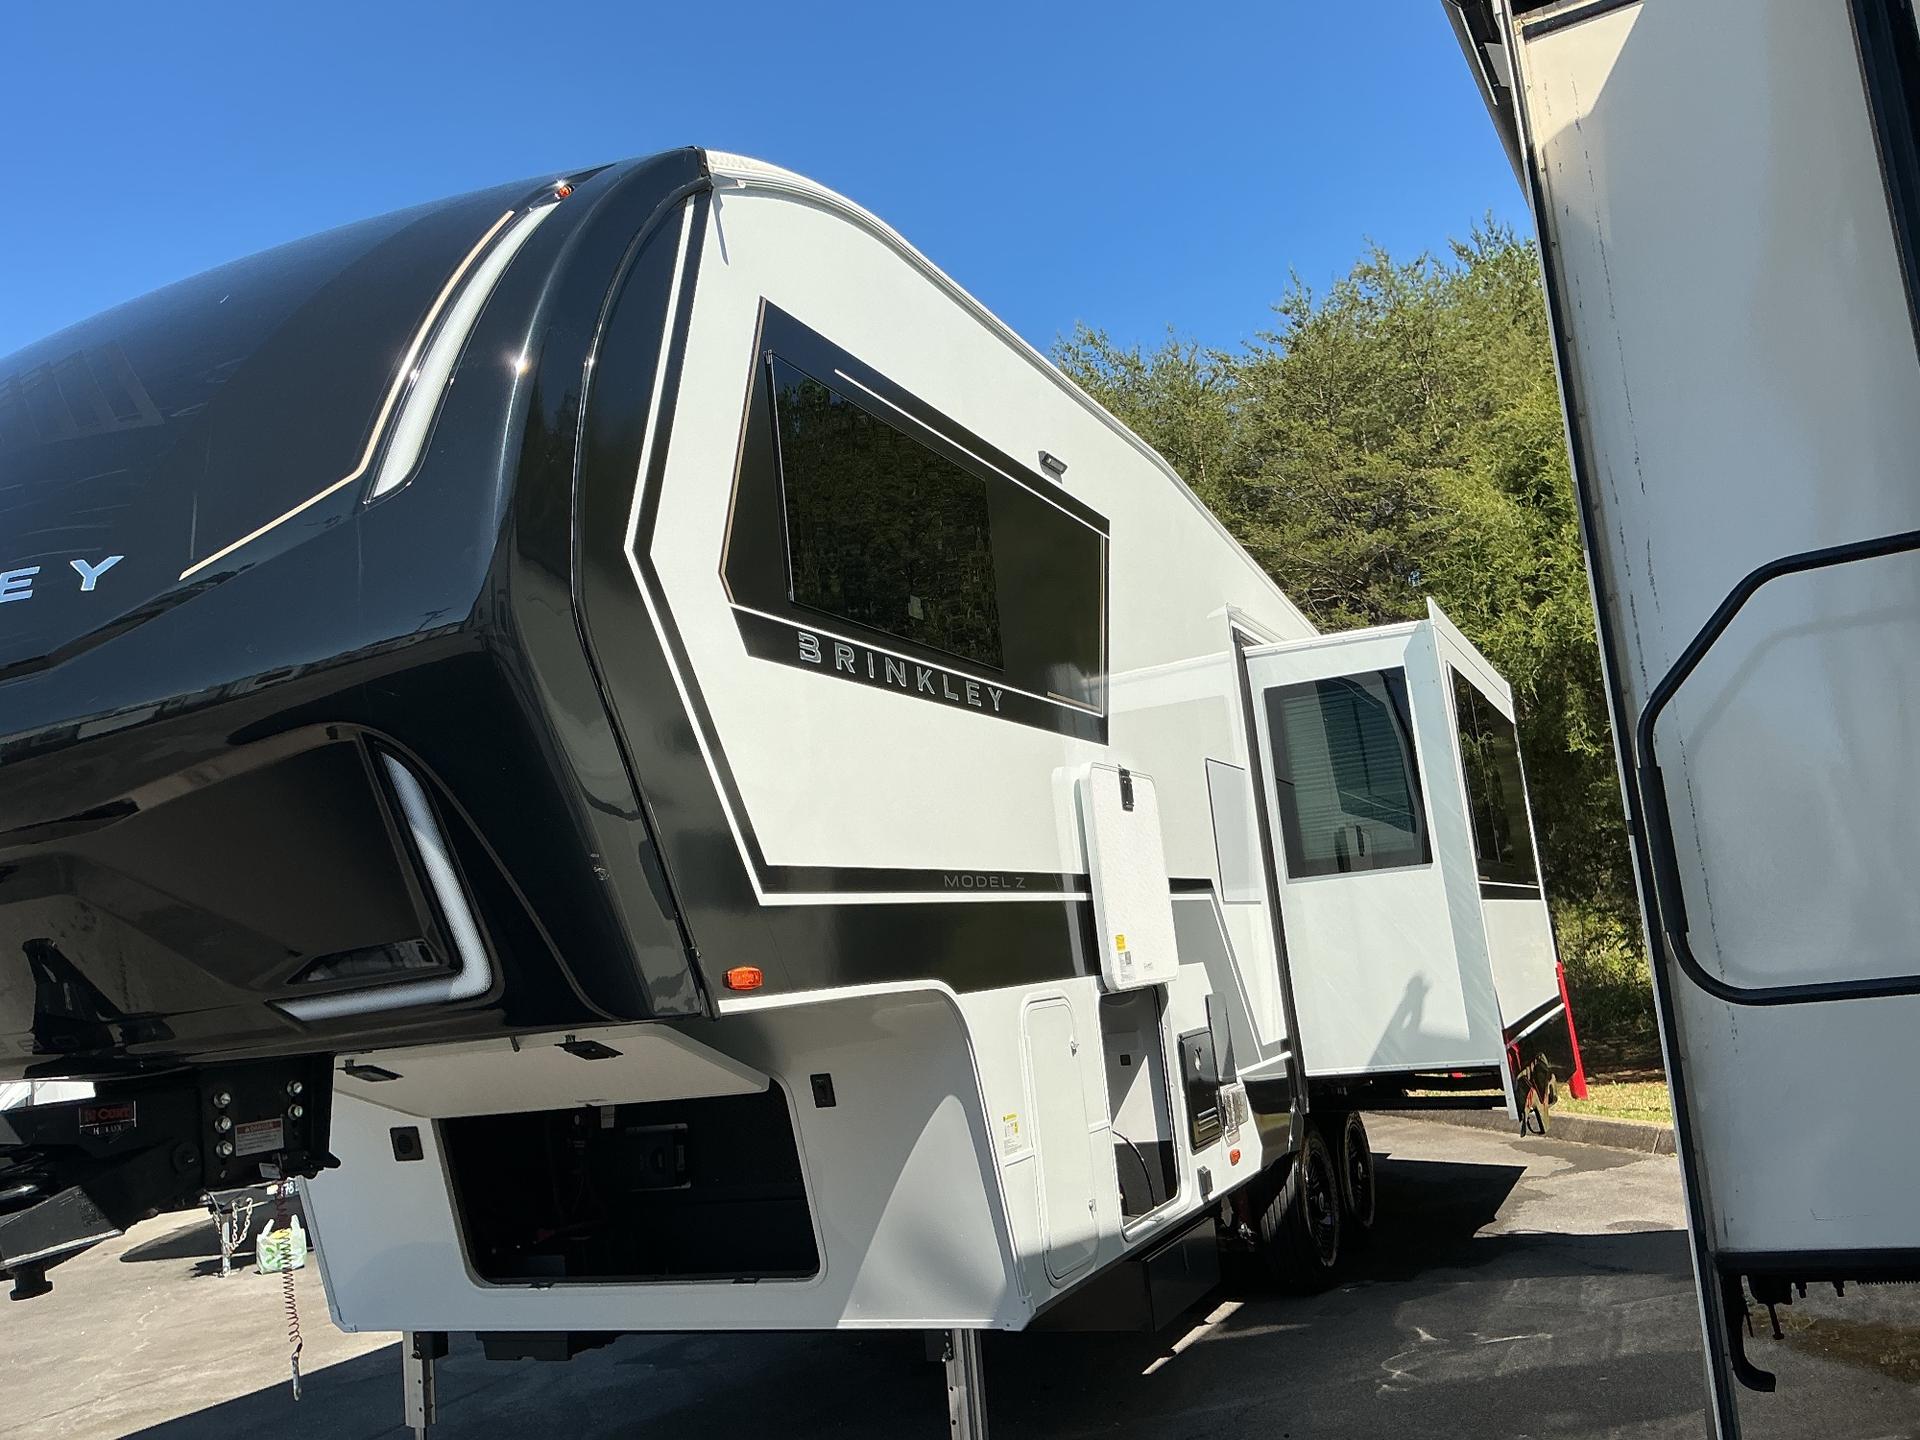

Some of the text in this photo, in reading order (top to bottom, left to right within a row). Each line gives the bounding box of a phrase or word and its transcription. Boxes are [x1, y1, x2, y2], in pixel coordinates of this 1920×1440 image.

[798, 631, 1003, 712] BRINKLEY
[943, 874, 1026, 888] MODEL Z
